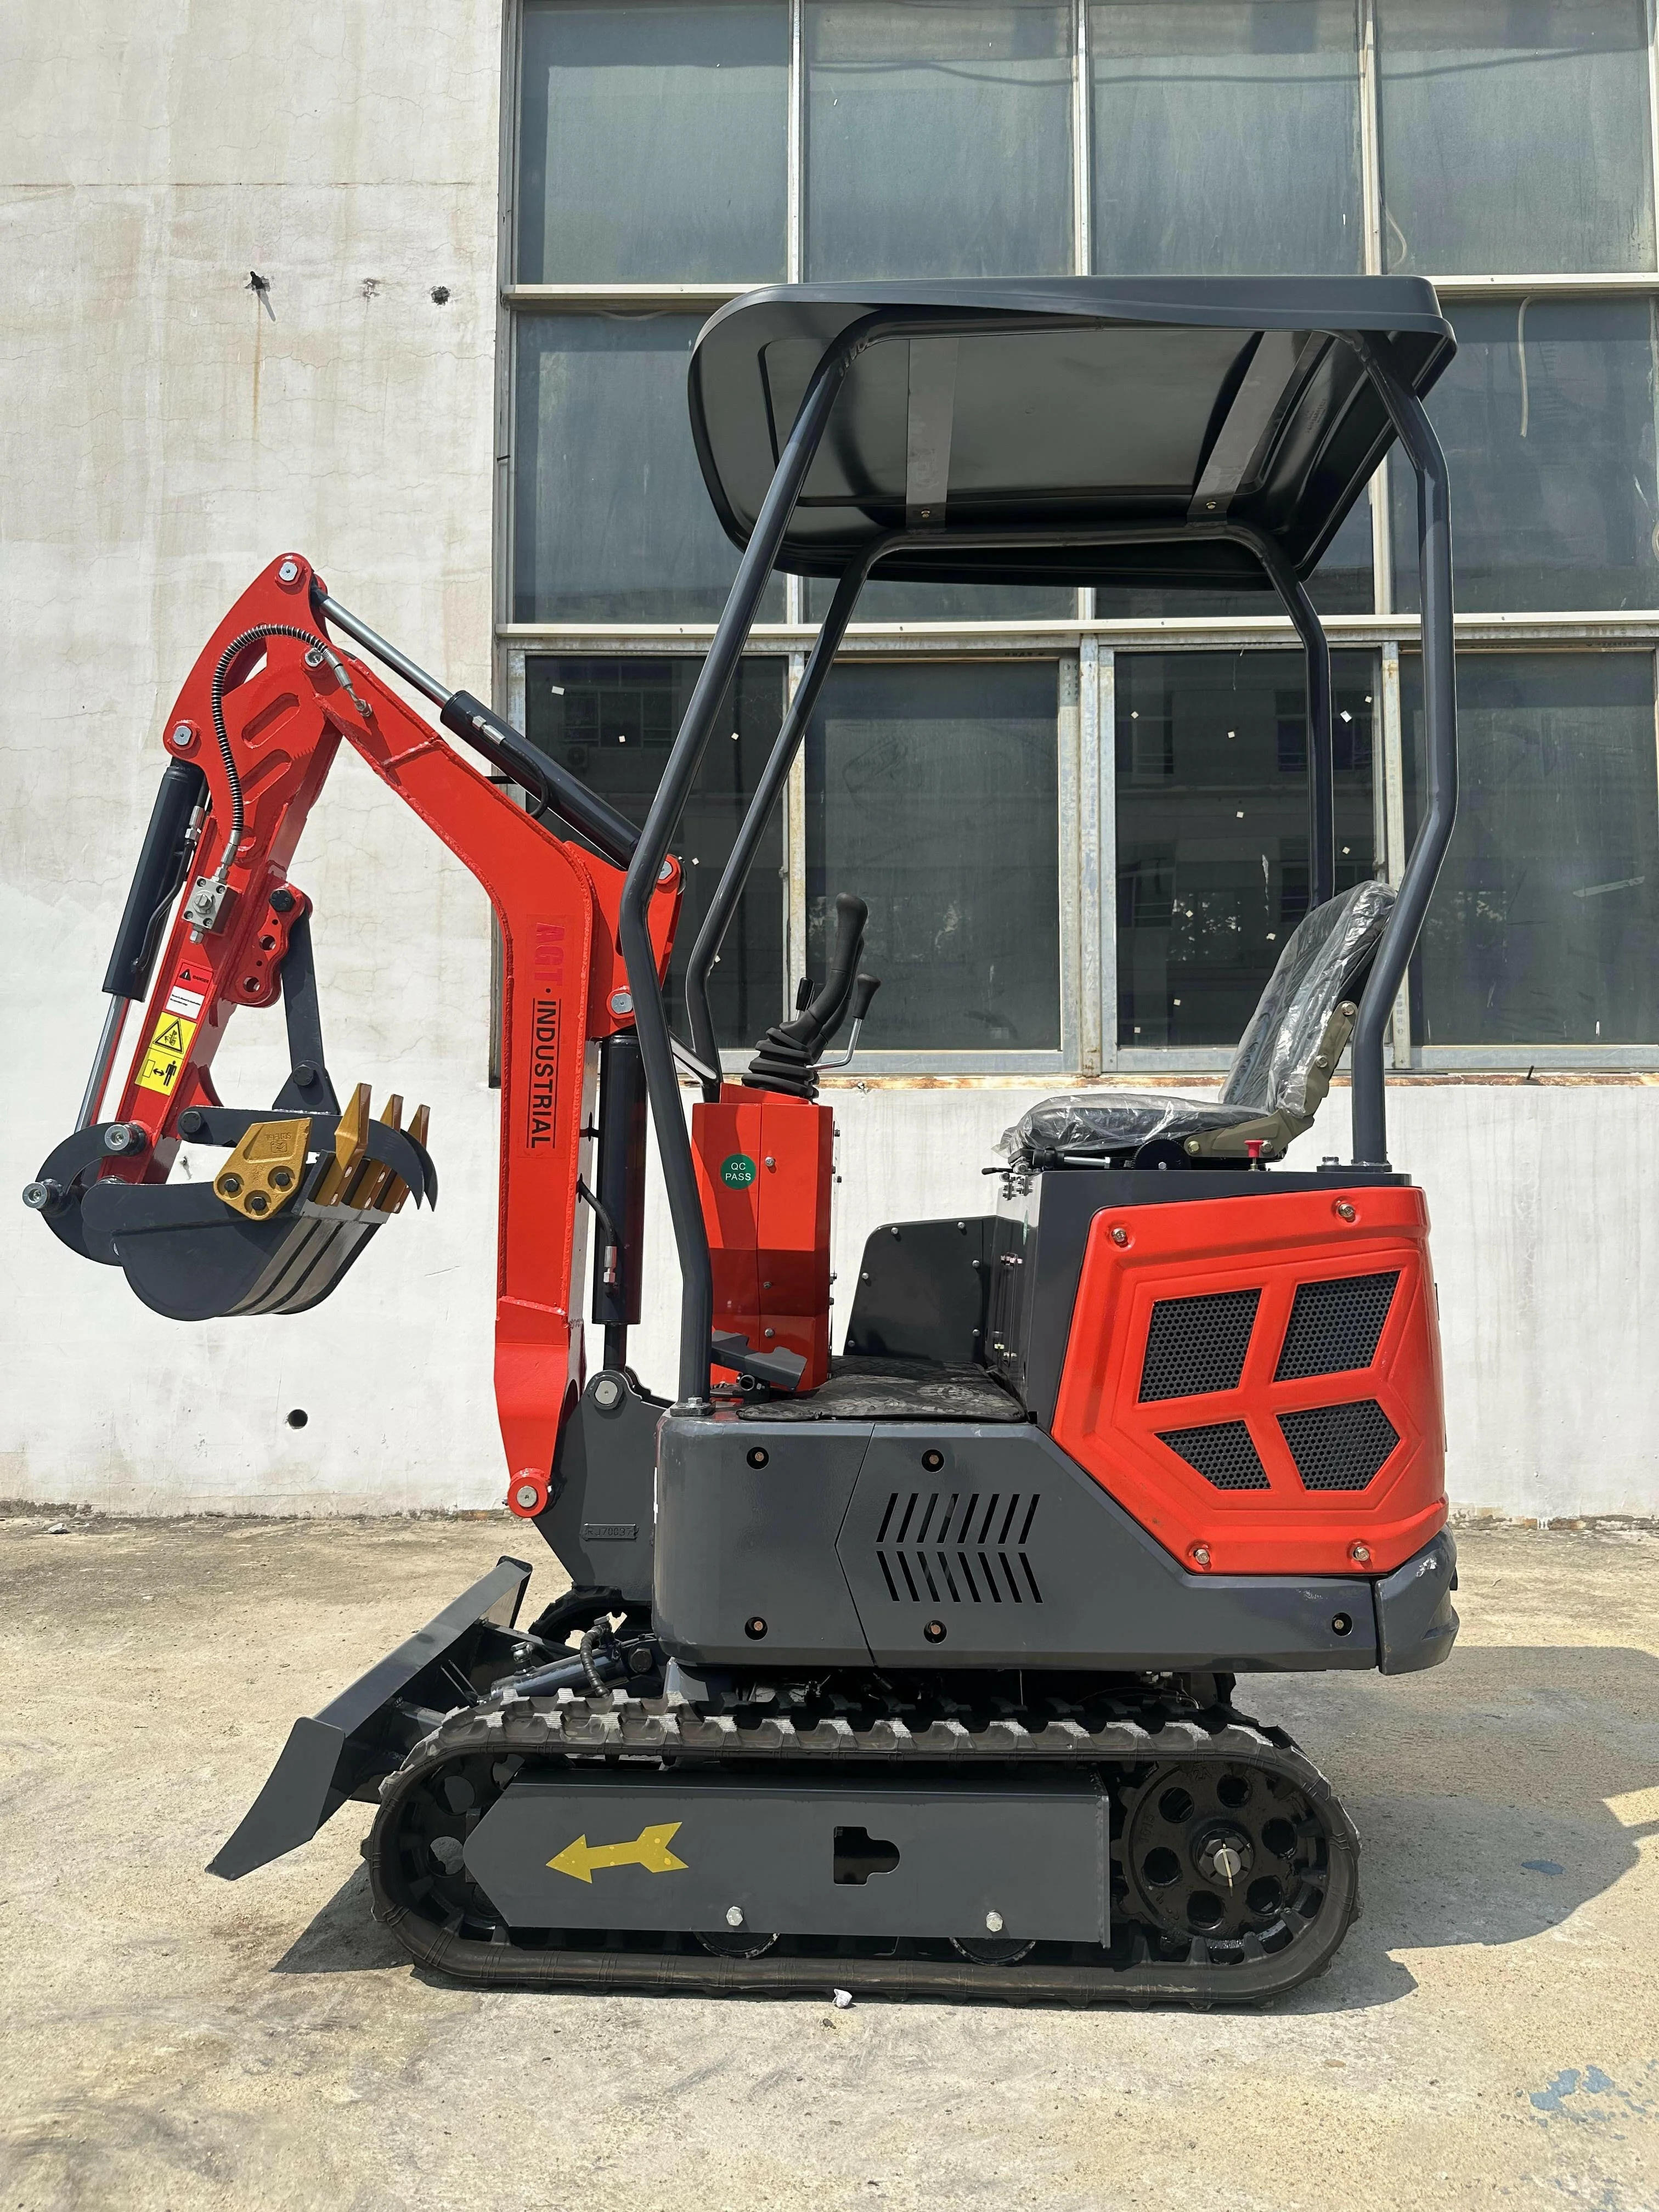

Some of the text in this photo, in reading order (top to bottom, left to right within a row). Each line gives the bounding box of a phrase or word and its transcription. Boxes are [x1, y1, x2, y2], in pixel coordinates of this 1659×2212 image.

[531, 922, 566, 1148] AGT INDUSTRIAL
[731, 1162, 746, 1170] QC
